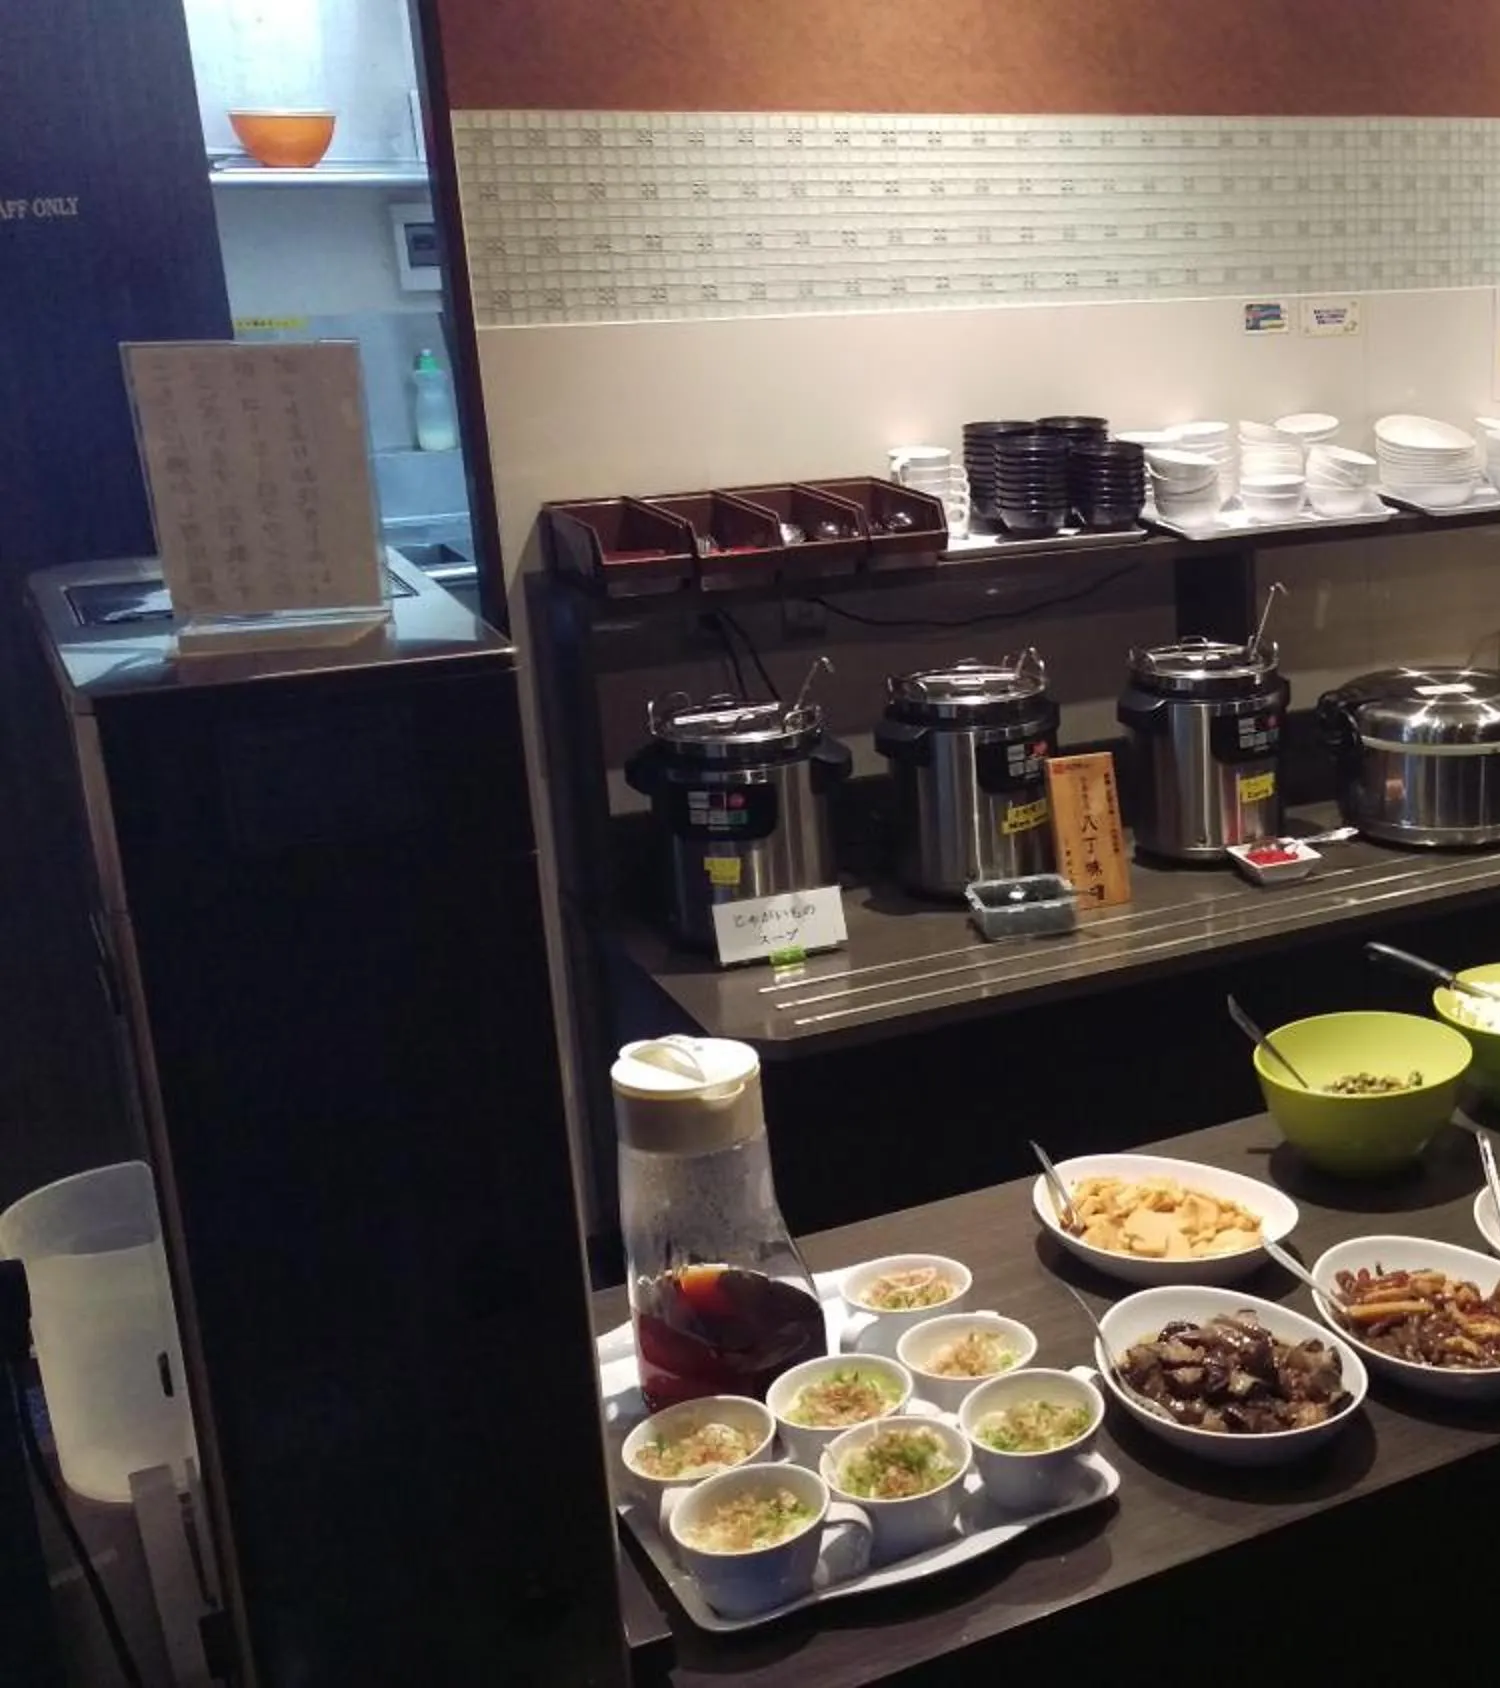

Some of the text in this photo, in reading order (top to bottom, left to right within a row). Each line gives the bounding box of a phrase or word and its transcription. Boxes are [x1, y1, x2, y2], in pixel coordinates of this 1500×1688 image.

[33, 197, 79, 217] ONLY
[761, 928, 799, 944] スープ
